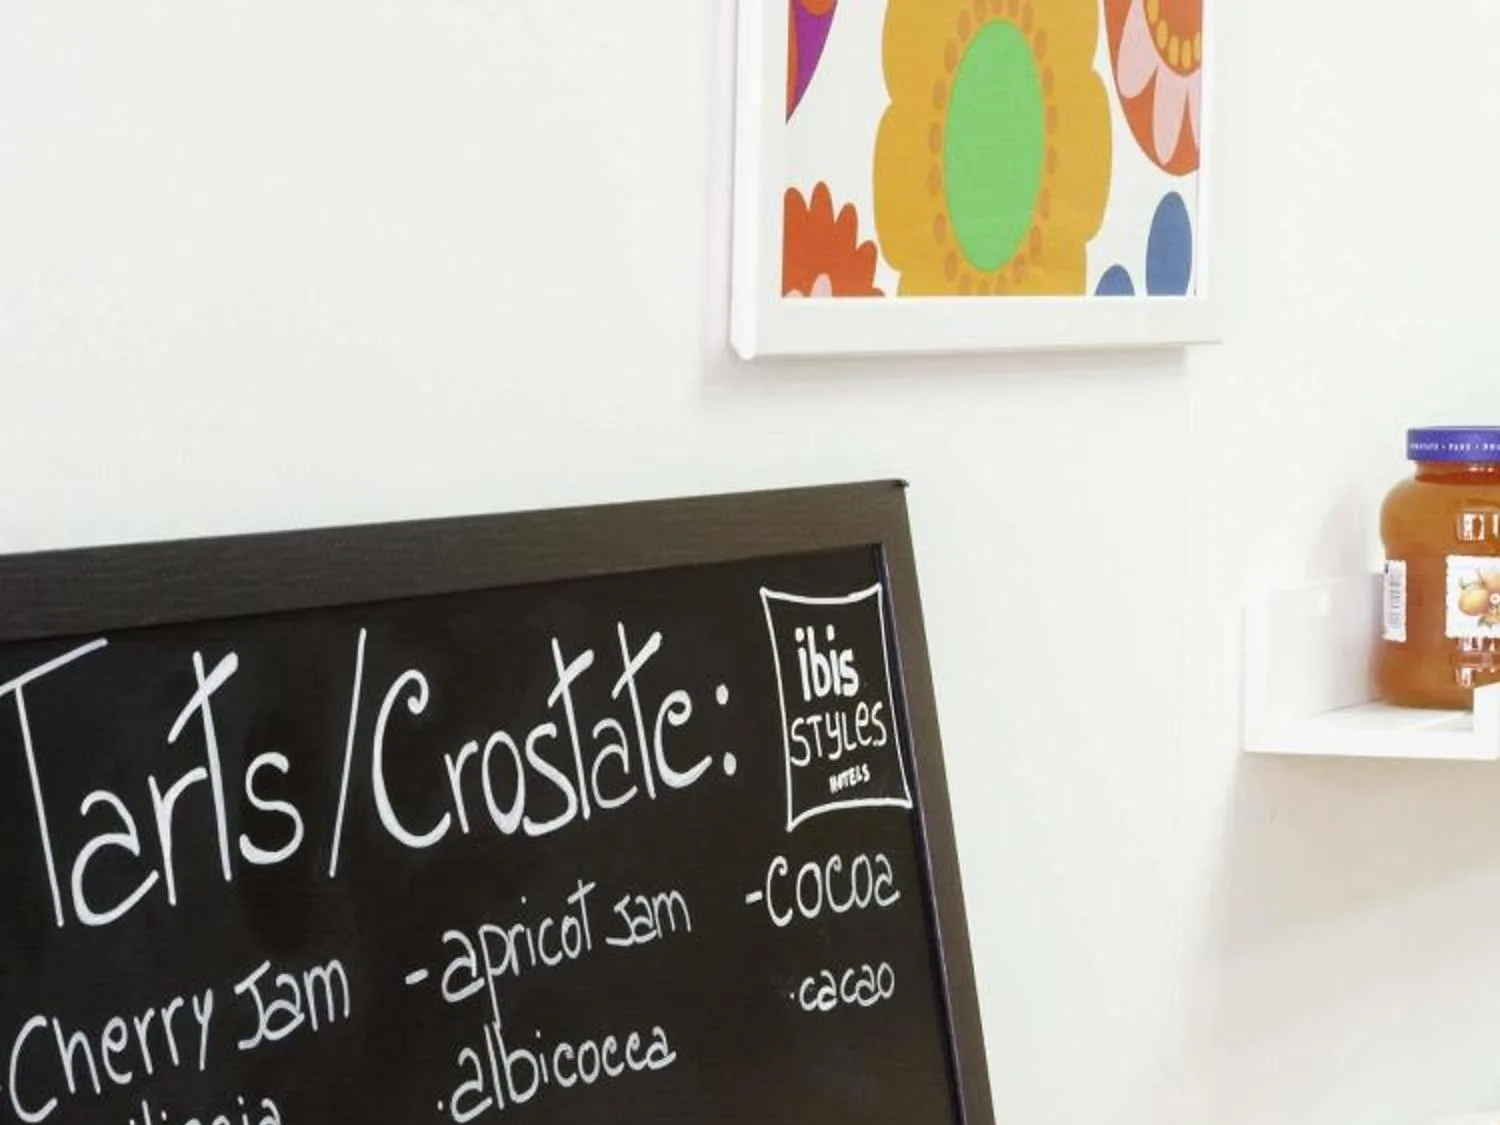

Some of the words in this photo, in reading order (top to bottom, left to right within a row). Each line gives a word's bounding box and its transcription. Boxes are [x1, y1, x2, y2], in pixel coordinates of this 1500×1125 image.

[795, 624, 860, 702] ibis
[829, 763, 871, 794] HOTELS
[10, 988, 214, 1123] Cherry
[234, 959, 350, 1051] Jam
